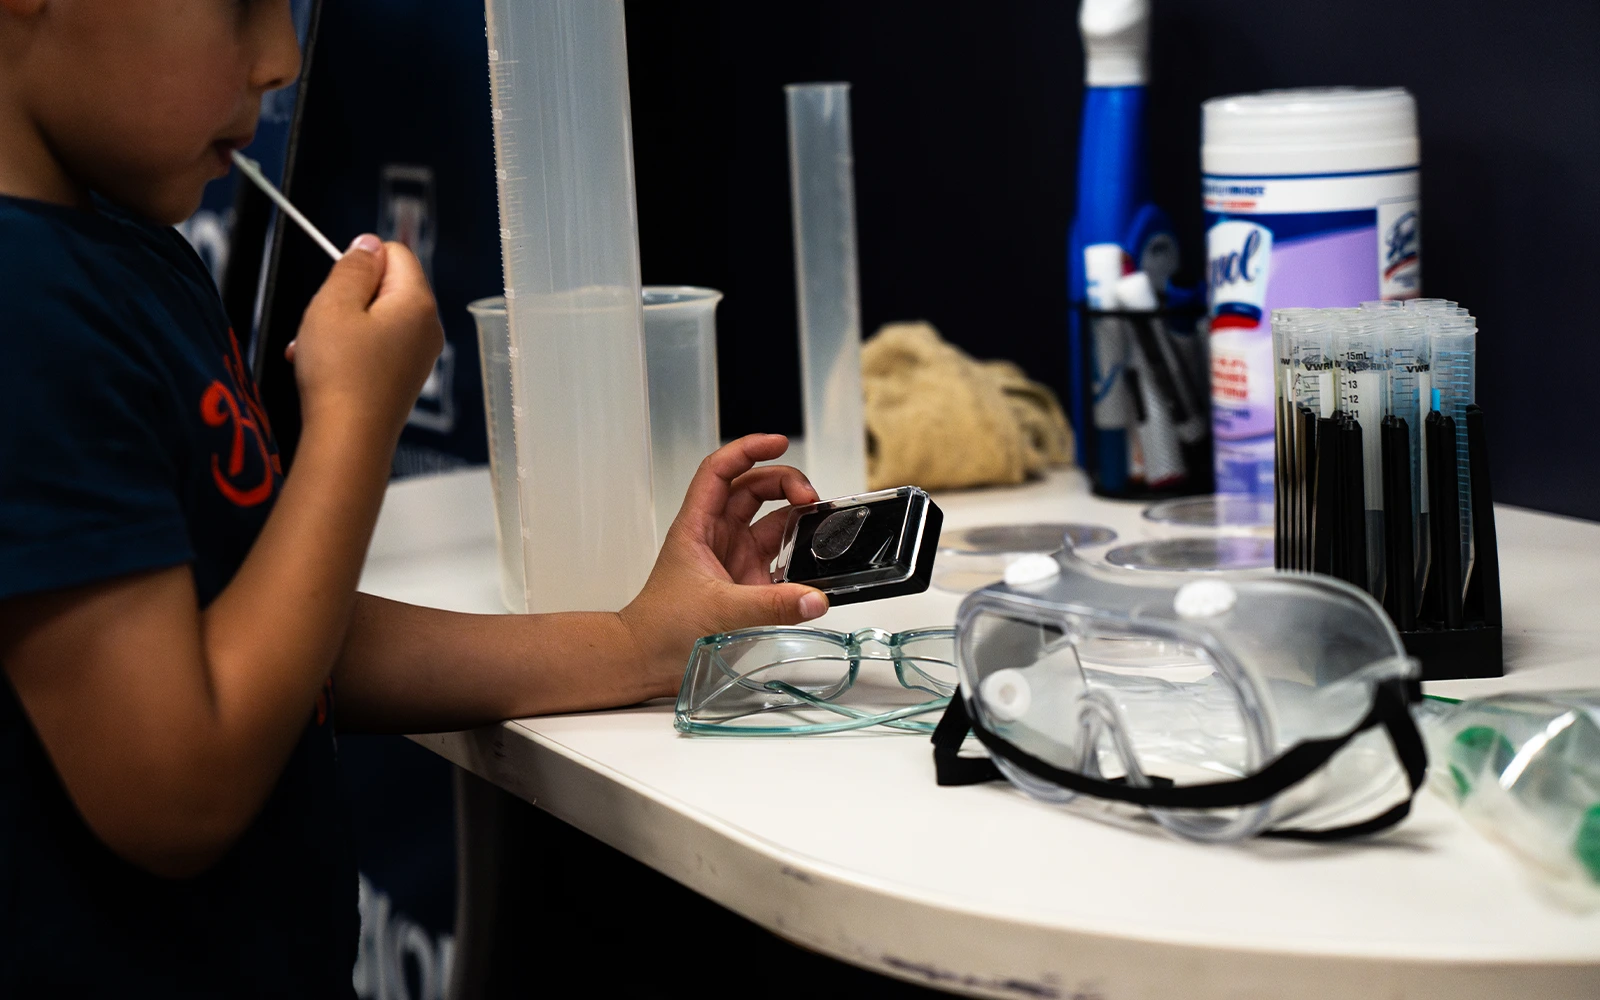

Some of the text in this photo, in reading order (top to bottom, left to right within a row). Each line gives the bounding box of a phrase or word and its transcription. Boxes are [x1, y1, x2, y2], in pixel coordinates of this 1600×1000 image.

[1346, 351, 1369, 360] 15mL
[1347, 380, 1358, 389] 13
[1348, 394, 1359, 404] 12
